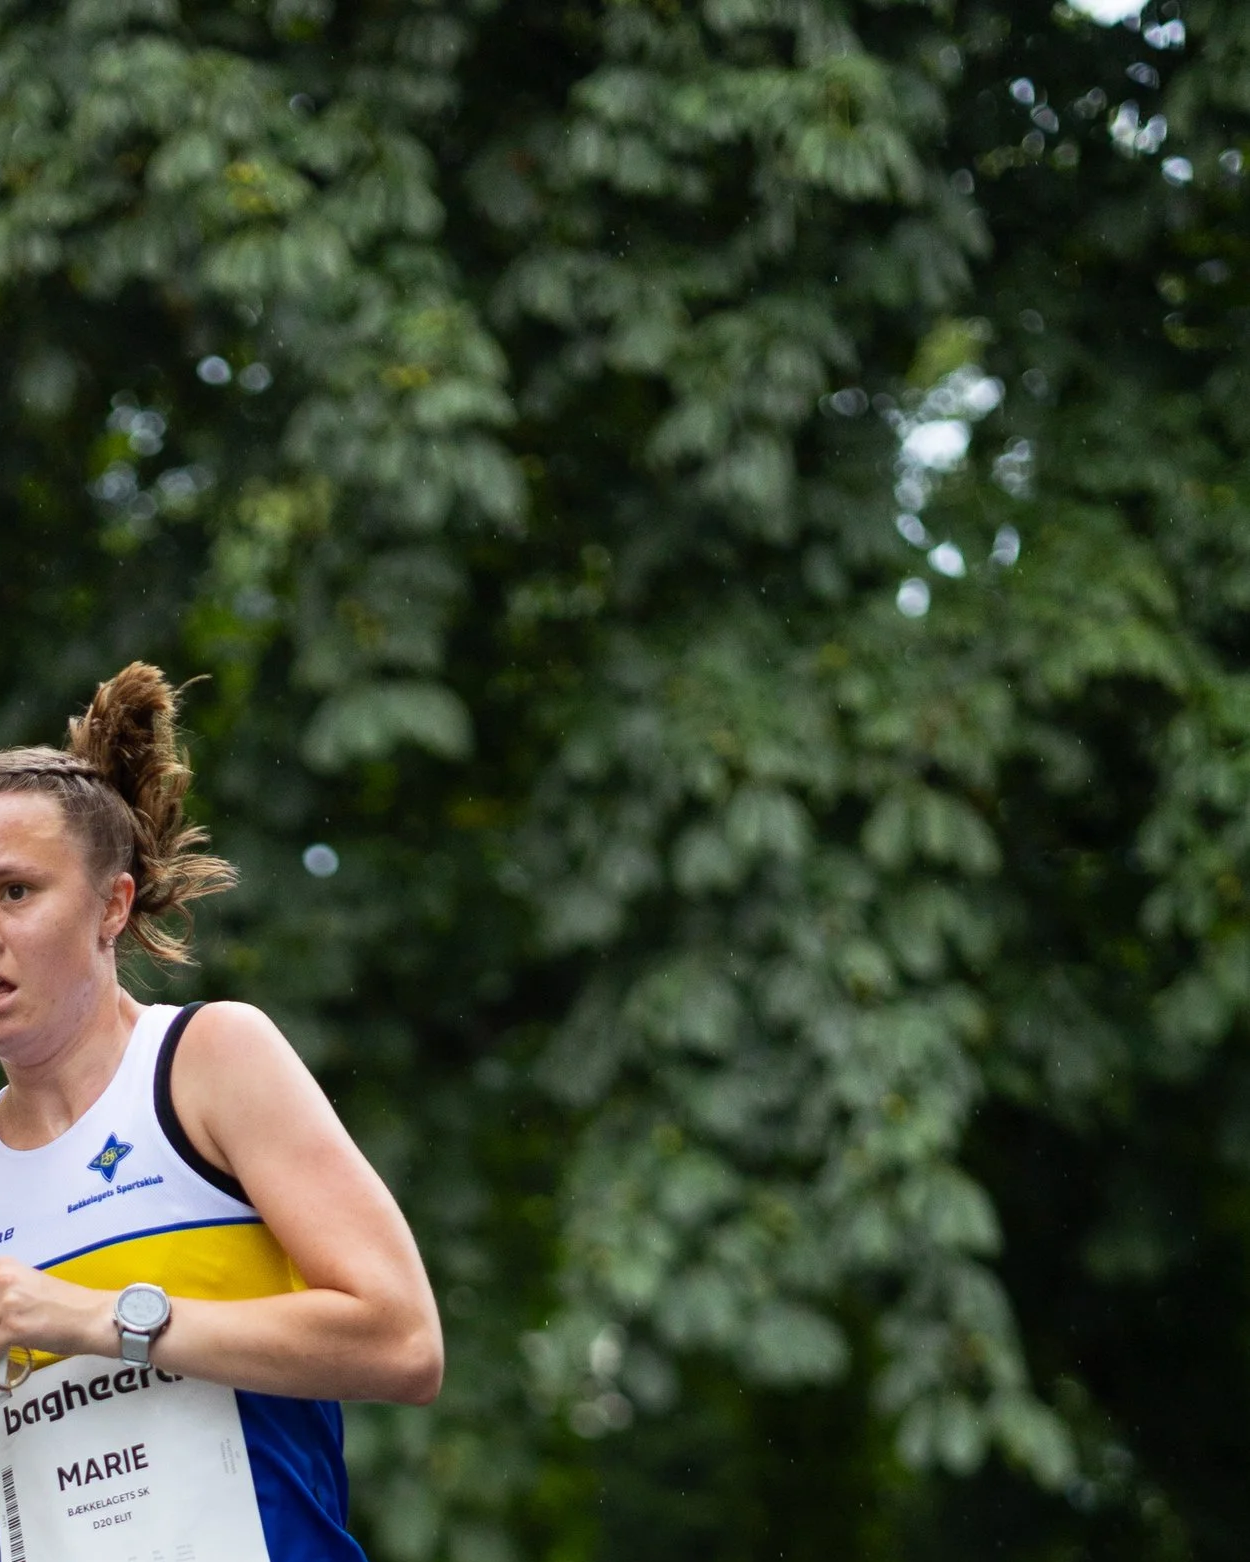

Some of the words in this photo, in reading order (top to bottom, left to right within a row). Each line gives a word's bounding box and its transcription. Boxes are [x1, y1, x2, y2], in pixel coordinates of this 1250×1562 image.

[116, 1174, 164, 1195] Sportsklub
[56, 1443, 149, 1492] MARIE
[67, 1491, 136, 1517] BÆKKELAGETS
[137, 1487, 150, 1498] SK
[92, 1517, 113, 1530] D20
[114, 1511, 133, 1525] ELIT
